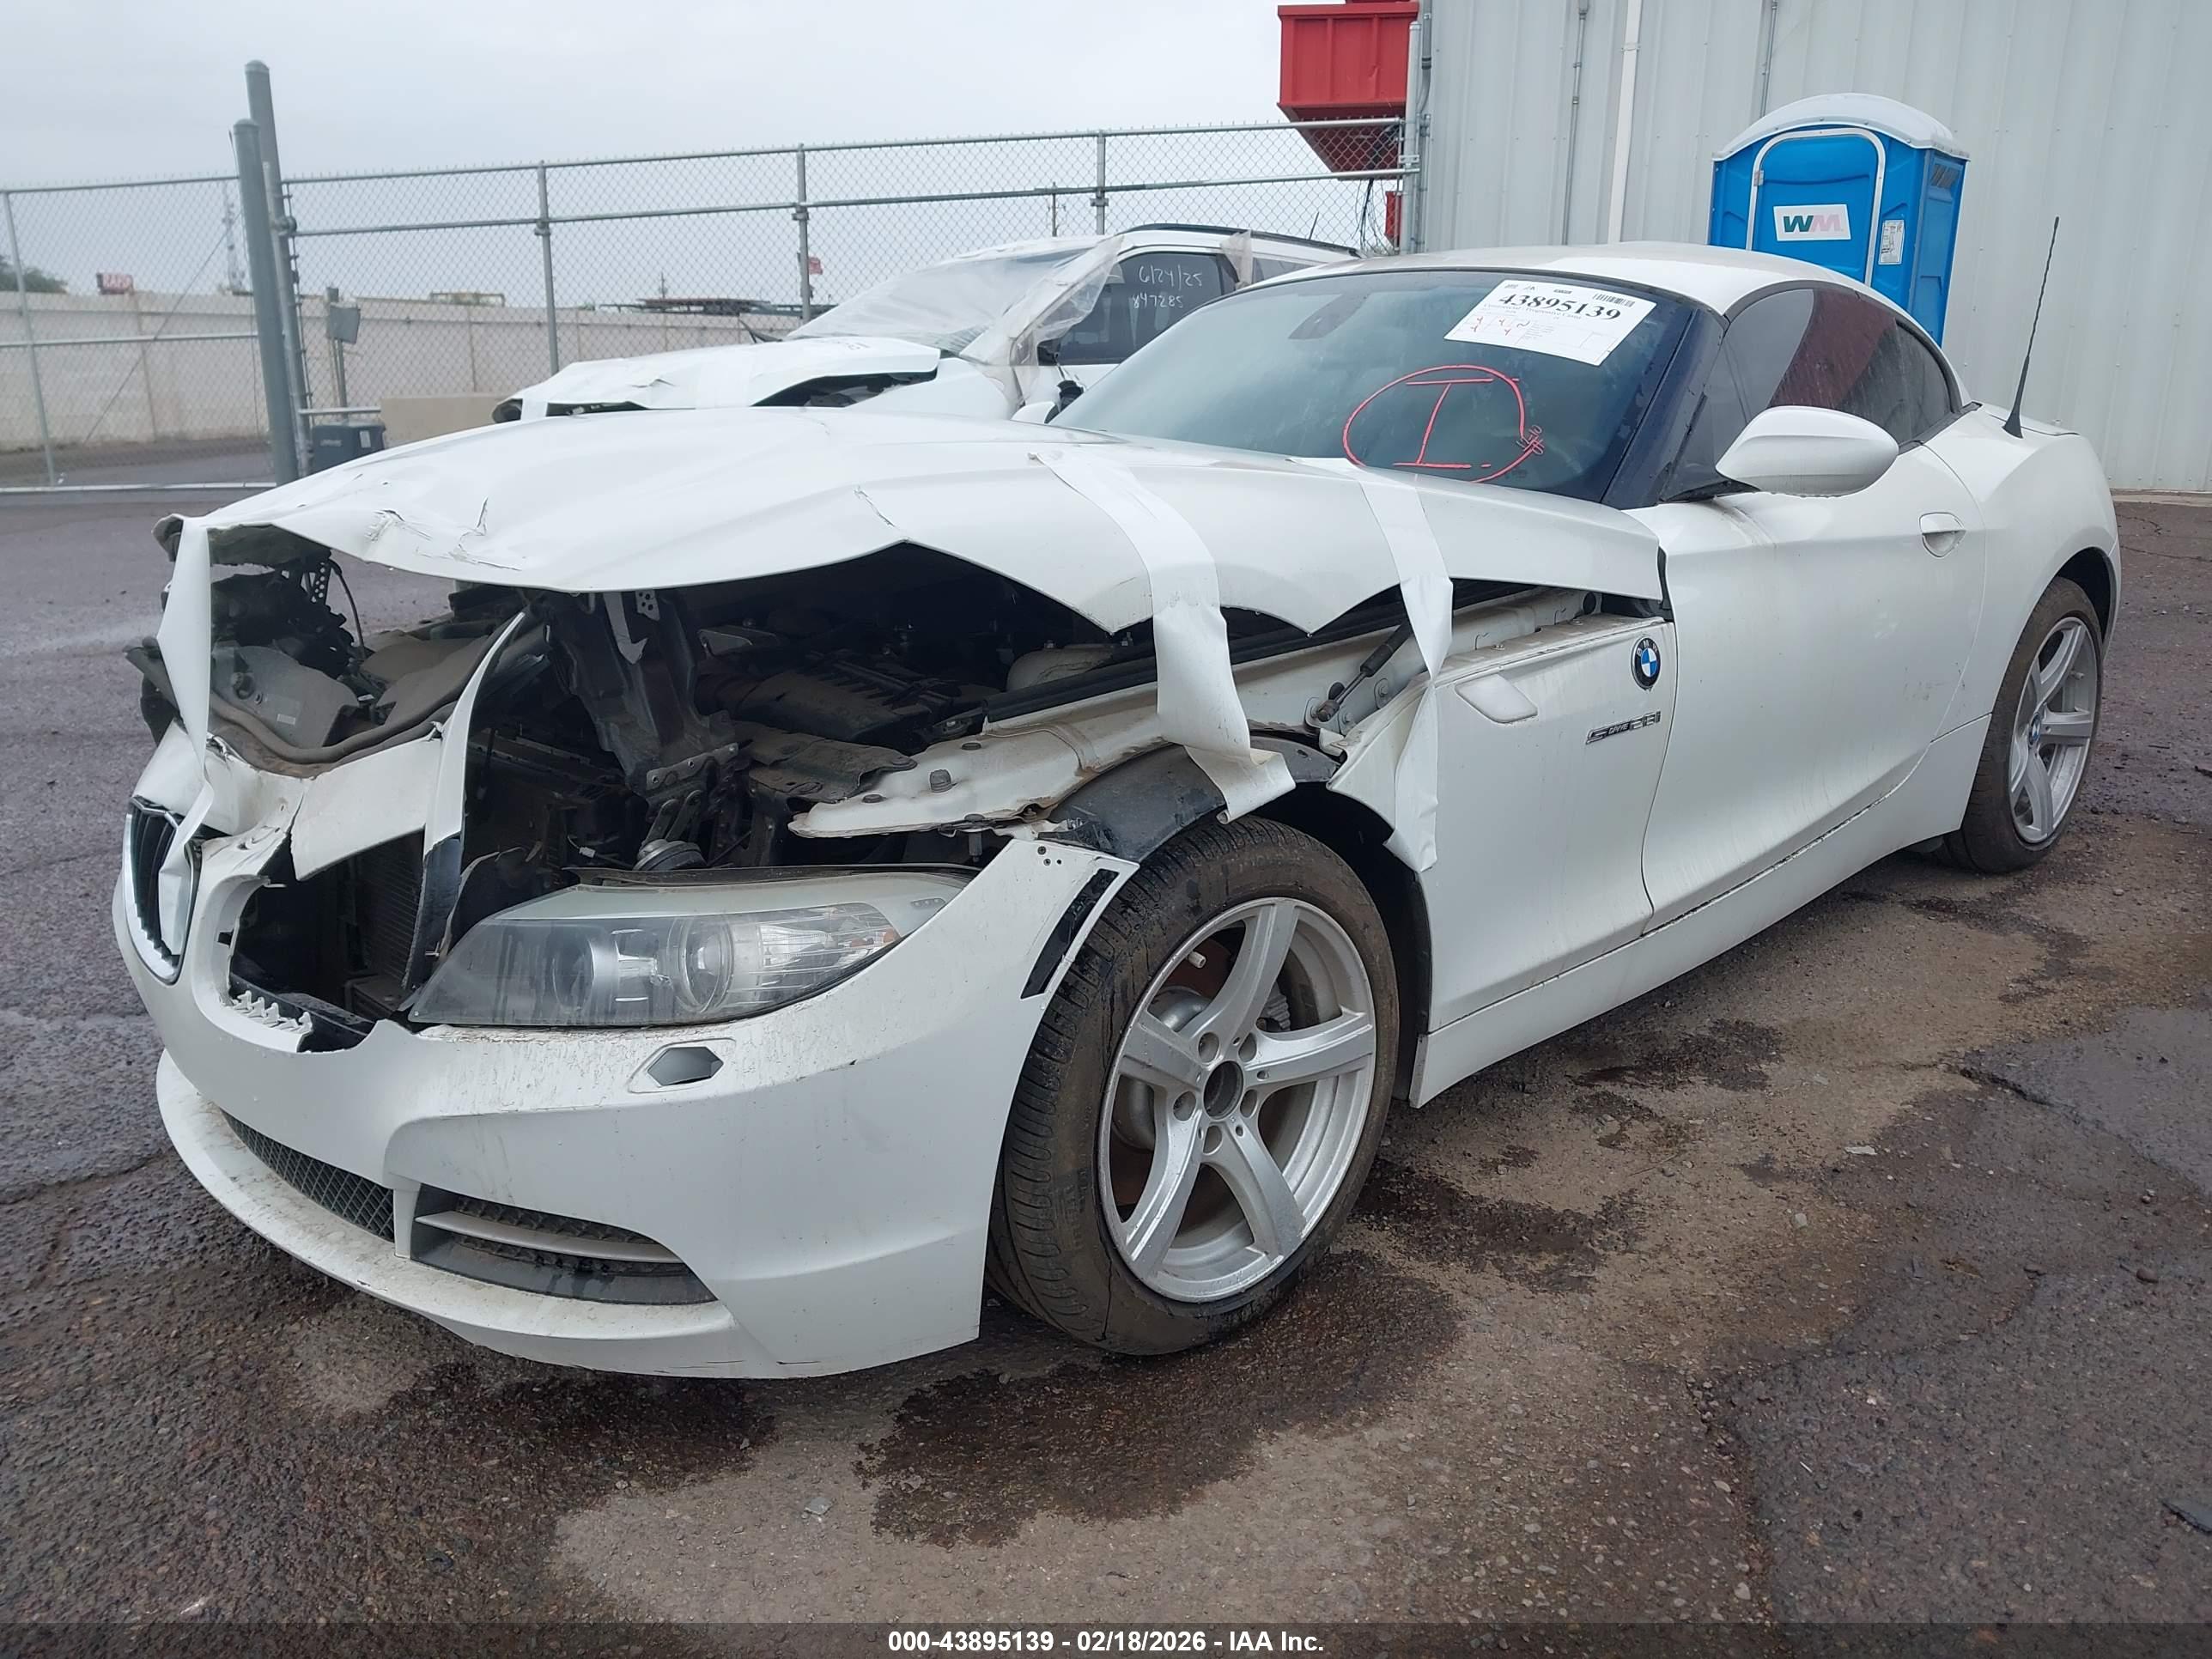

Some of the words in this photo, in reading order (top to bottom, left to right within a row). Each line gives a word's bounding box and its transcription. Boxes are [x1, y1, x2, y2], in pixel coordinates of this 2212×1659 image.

[1784, 215, 1842, 233] WM
[1139, 264, 1202, 292] 6/24/25
[1133, 292, 1183, 308] 847285
[1498, 293, 1621, 320] 43895139
[1636, 639, 1658, 658] BMW
